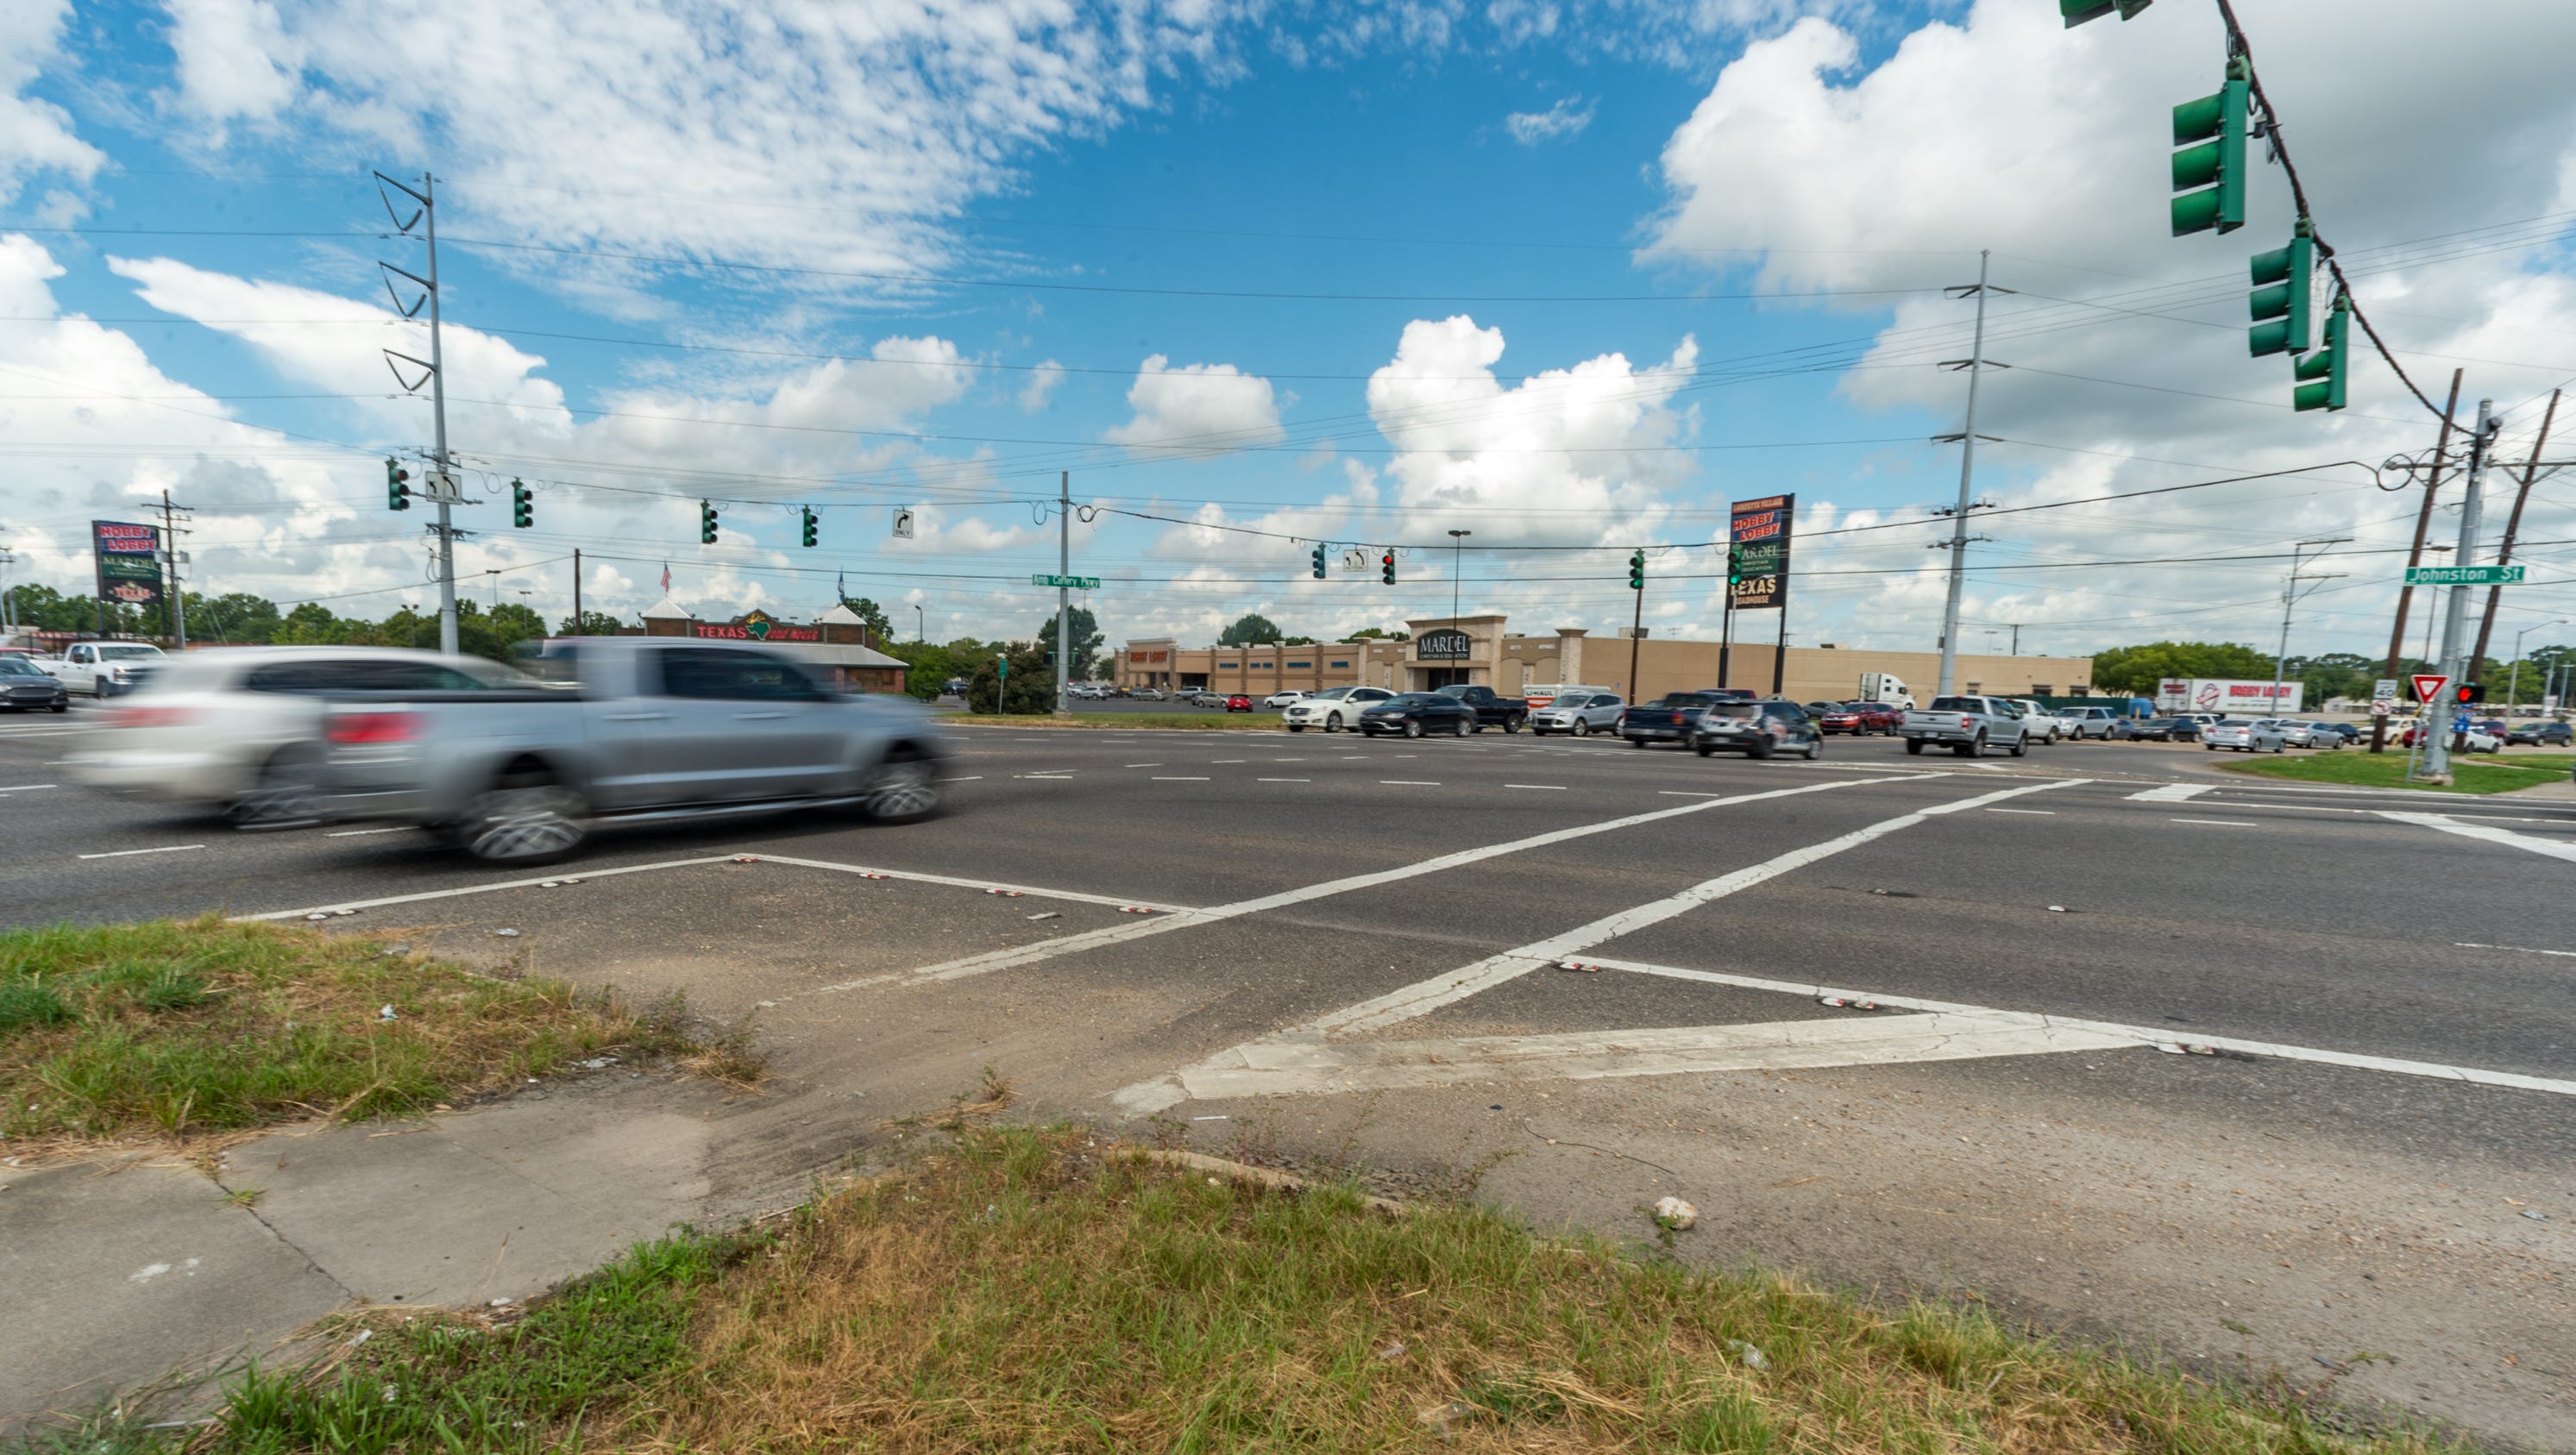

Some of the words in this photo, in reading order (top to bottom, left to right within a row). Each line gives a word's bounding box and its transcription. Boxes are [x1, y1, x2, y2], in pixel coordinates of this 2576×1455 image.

[1732, 511, 1775, 531] HOBBY
[99, 525, 151, 538] HOBBY
[1740, 522, 1781, 542] LOBBY
[107, 538, 156, 551] LOBBY
[1741, 545, 1778, 561] ARDEL
[2410, 568, 2488, 581] Johnston
[2499, 567, 2521, 580] St
[1034, 575, 1049, 586] Amb
[1080, 577, 1099, 588] Pkwy
[1737, 595, 1769, 605] OADHOUSE
[697, 625, 747, 639] TEXAS
[2263, 687, 2292, 698] LOBY
